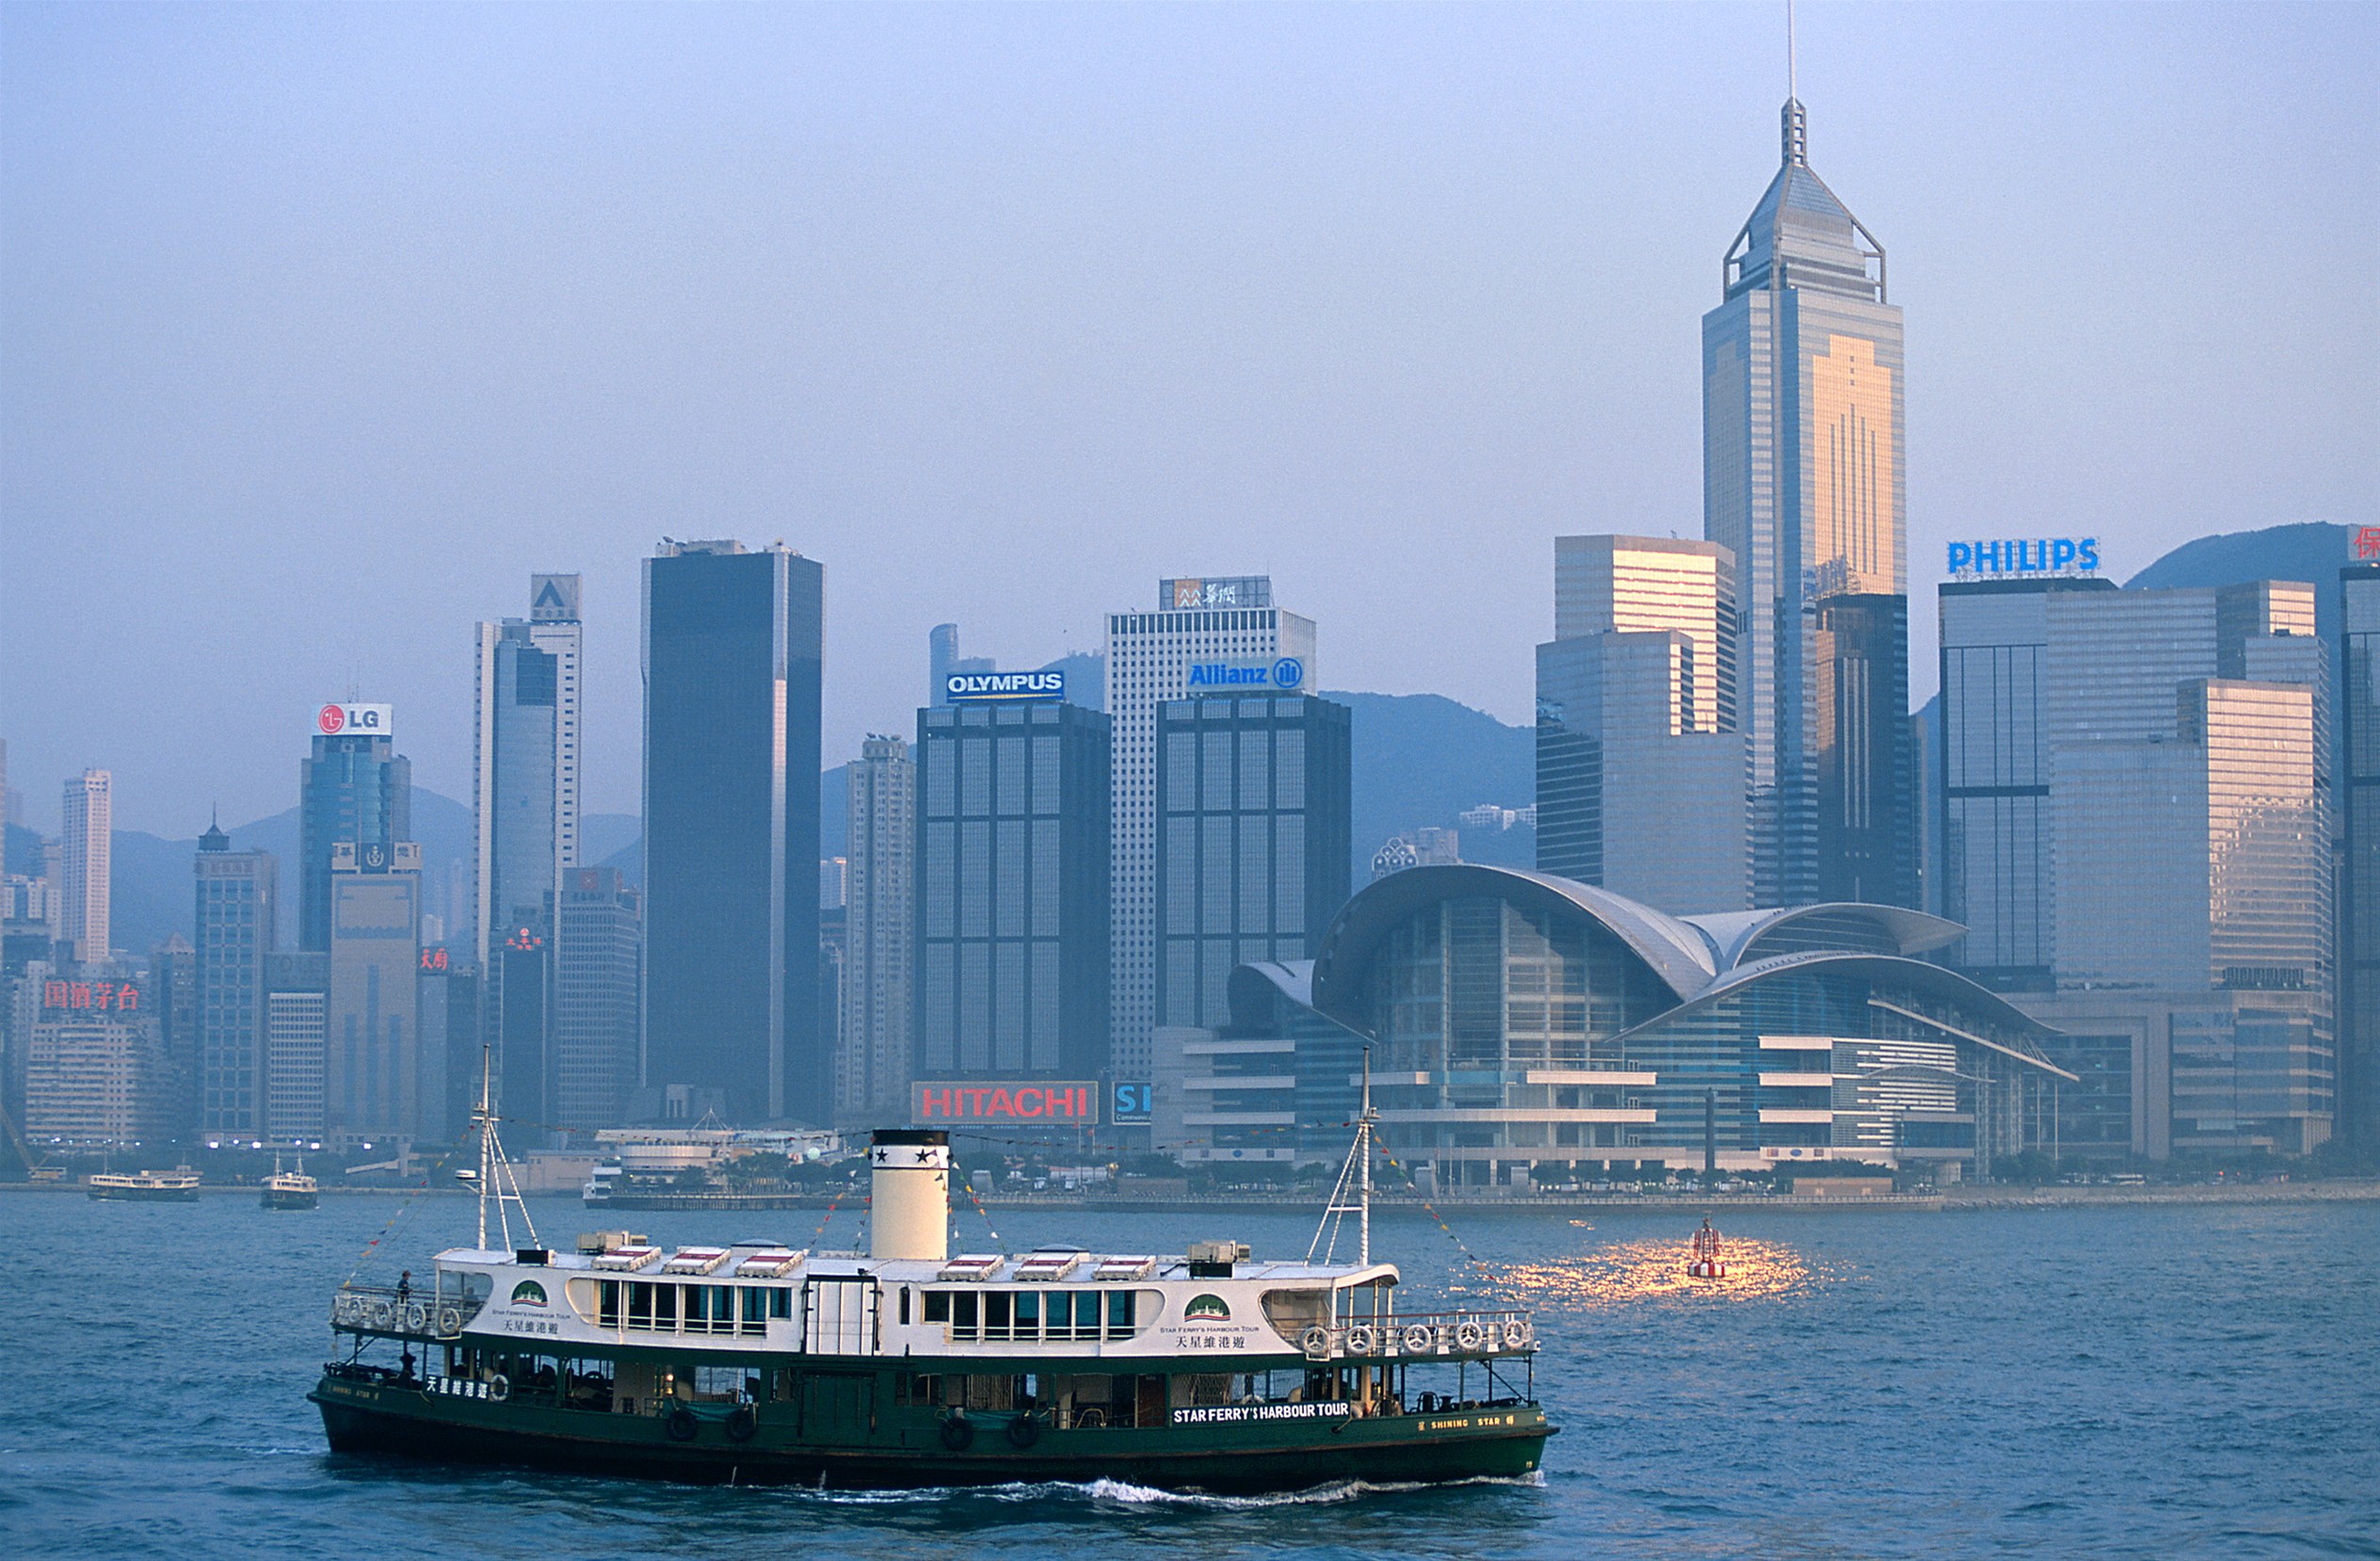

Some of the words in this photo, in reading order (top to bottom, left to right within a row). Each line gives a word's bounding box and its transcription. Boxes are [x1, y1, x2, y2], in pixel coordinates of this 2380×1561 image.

[1949, 539, 2099, 573] PHILIPS
[948, 673, 1062, 693] OLYMPUS
[1189, 664, 1268, 685] Allianz
[349, 710, 378, 728] LG
[45, 981, 139, 1010] 国酒茅台
[922, 1087, 1087, 1118] HITACHI
[1174, 1408, 1207, 1423] STAR
[1208, 1407, 1258, 1422] FERRY'S
[1260, 1404, 1315, 1419] HARBOUR
[1317, 1402, 1349, 1416] TOUR
[1431, 1419, 1469, 1429] SHINING
[1477, 1417, 1501, 1426] STAR
